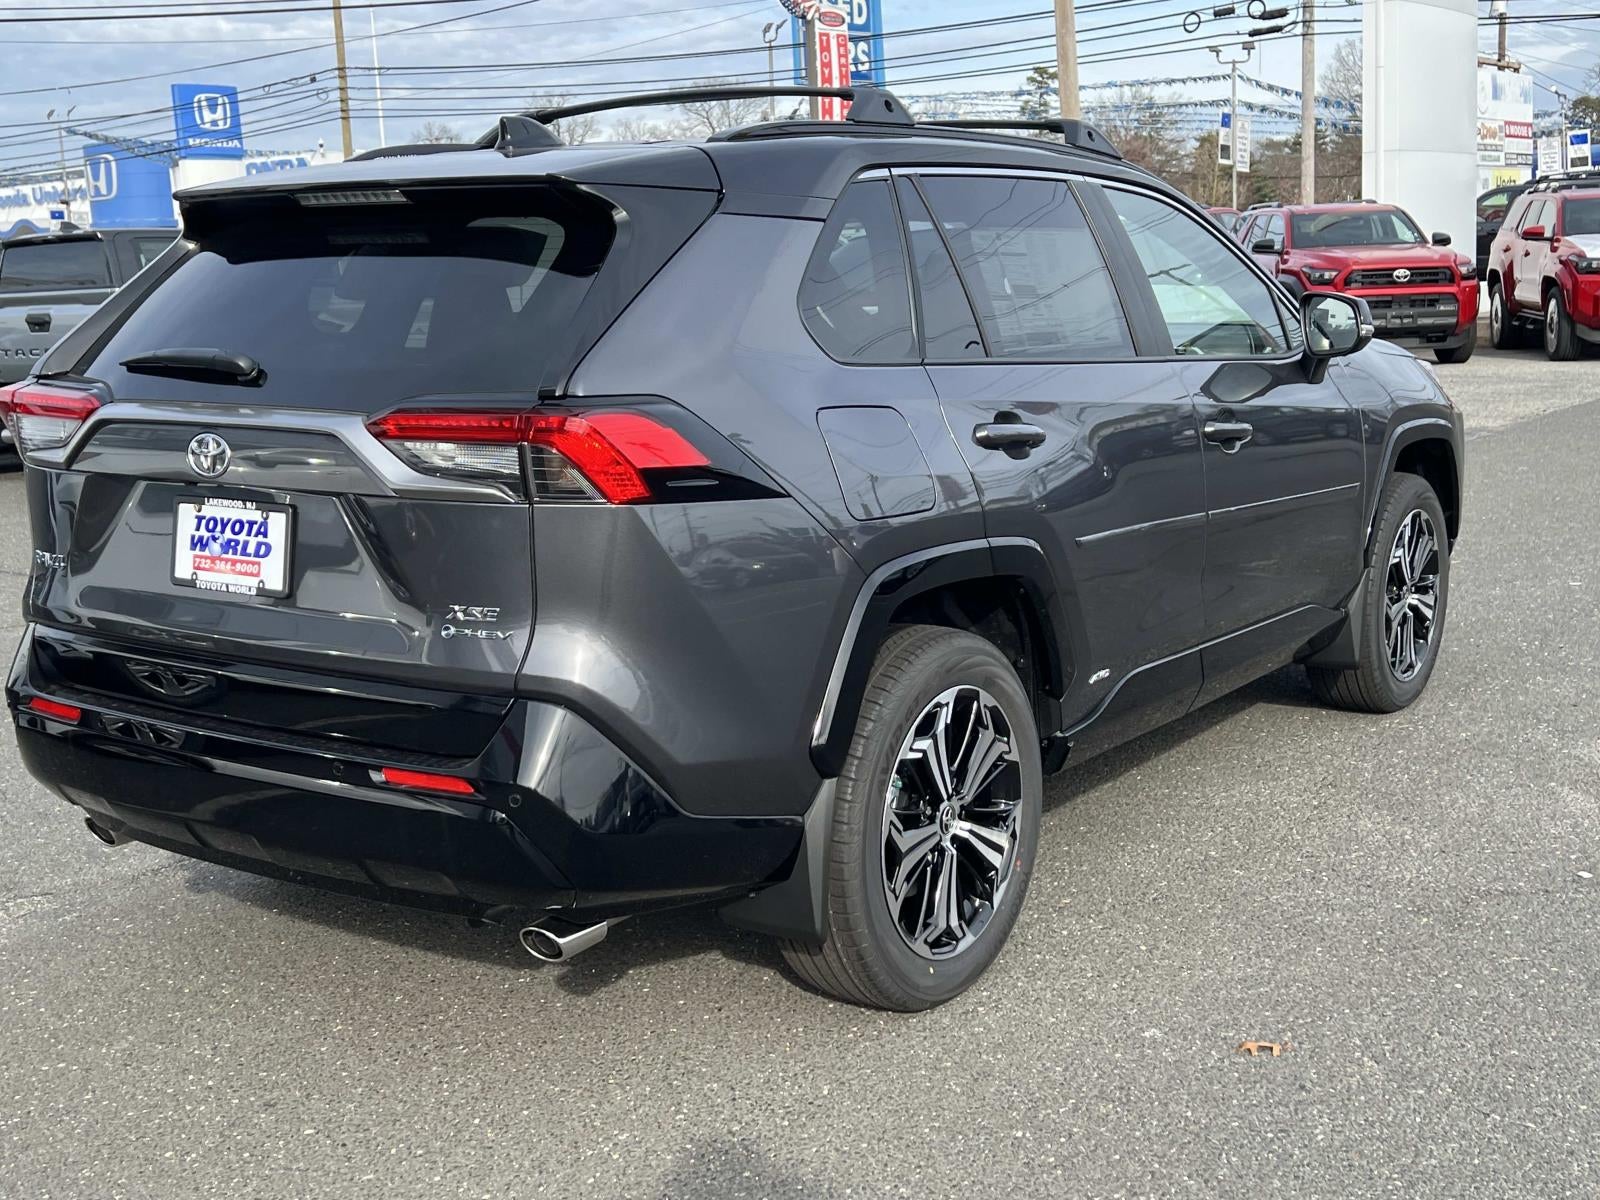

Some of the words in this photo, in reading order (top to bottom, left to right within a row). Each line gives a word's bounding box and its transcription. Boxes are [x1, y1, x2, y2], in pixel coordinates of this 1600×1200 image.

[188, 137, 242, 149] HONDA
[0, 348, 50, 359] TAC
[246, 501, 256, 511] NJ
[194, 514, 269, 539] TOYOTA
[195, 579, 228, 593] TOYOTA
[228, 583, 257, 596] WORLD
[445, 604, 501, 621] XSE
